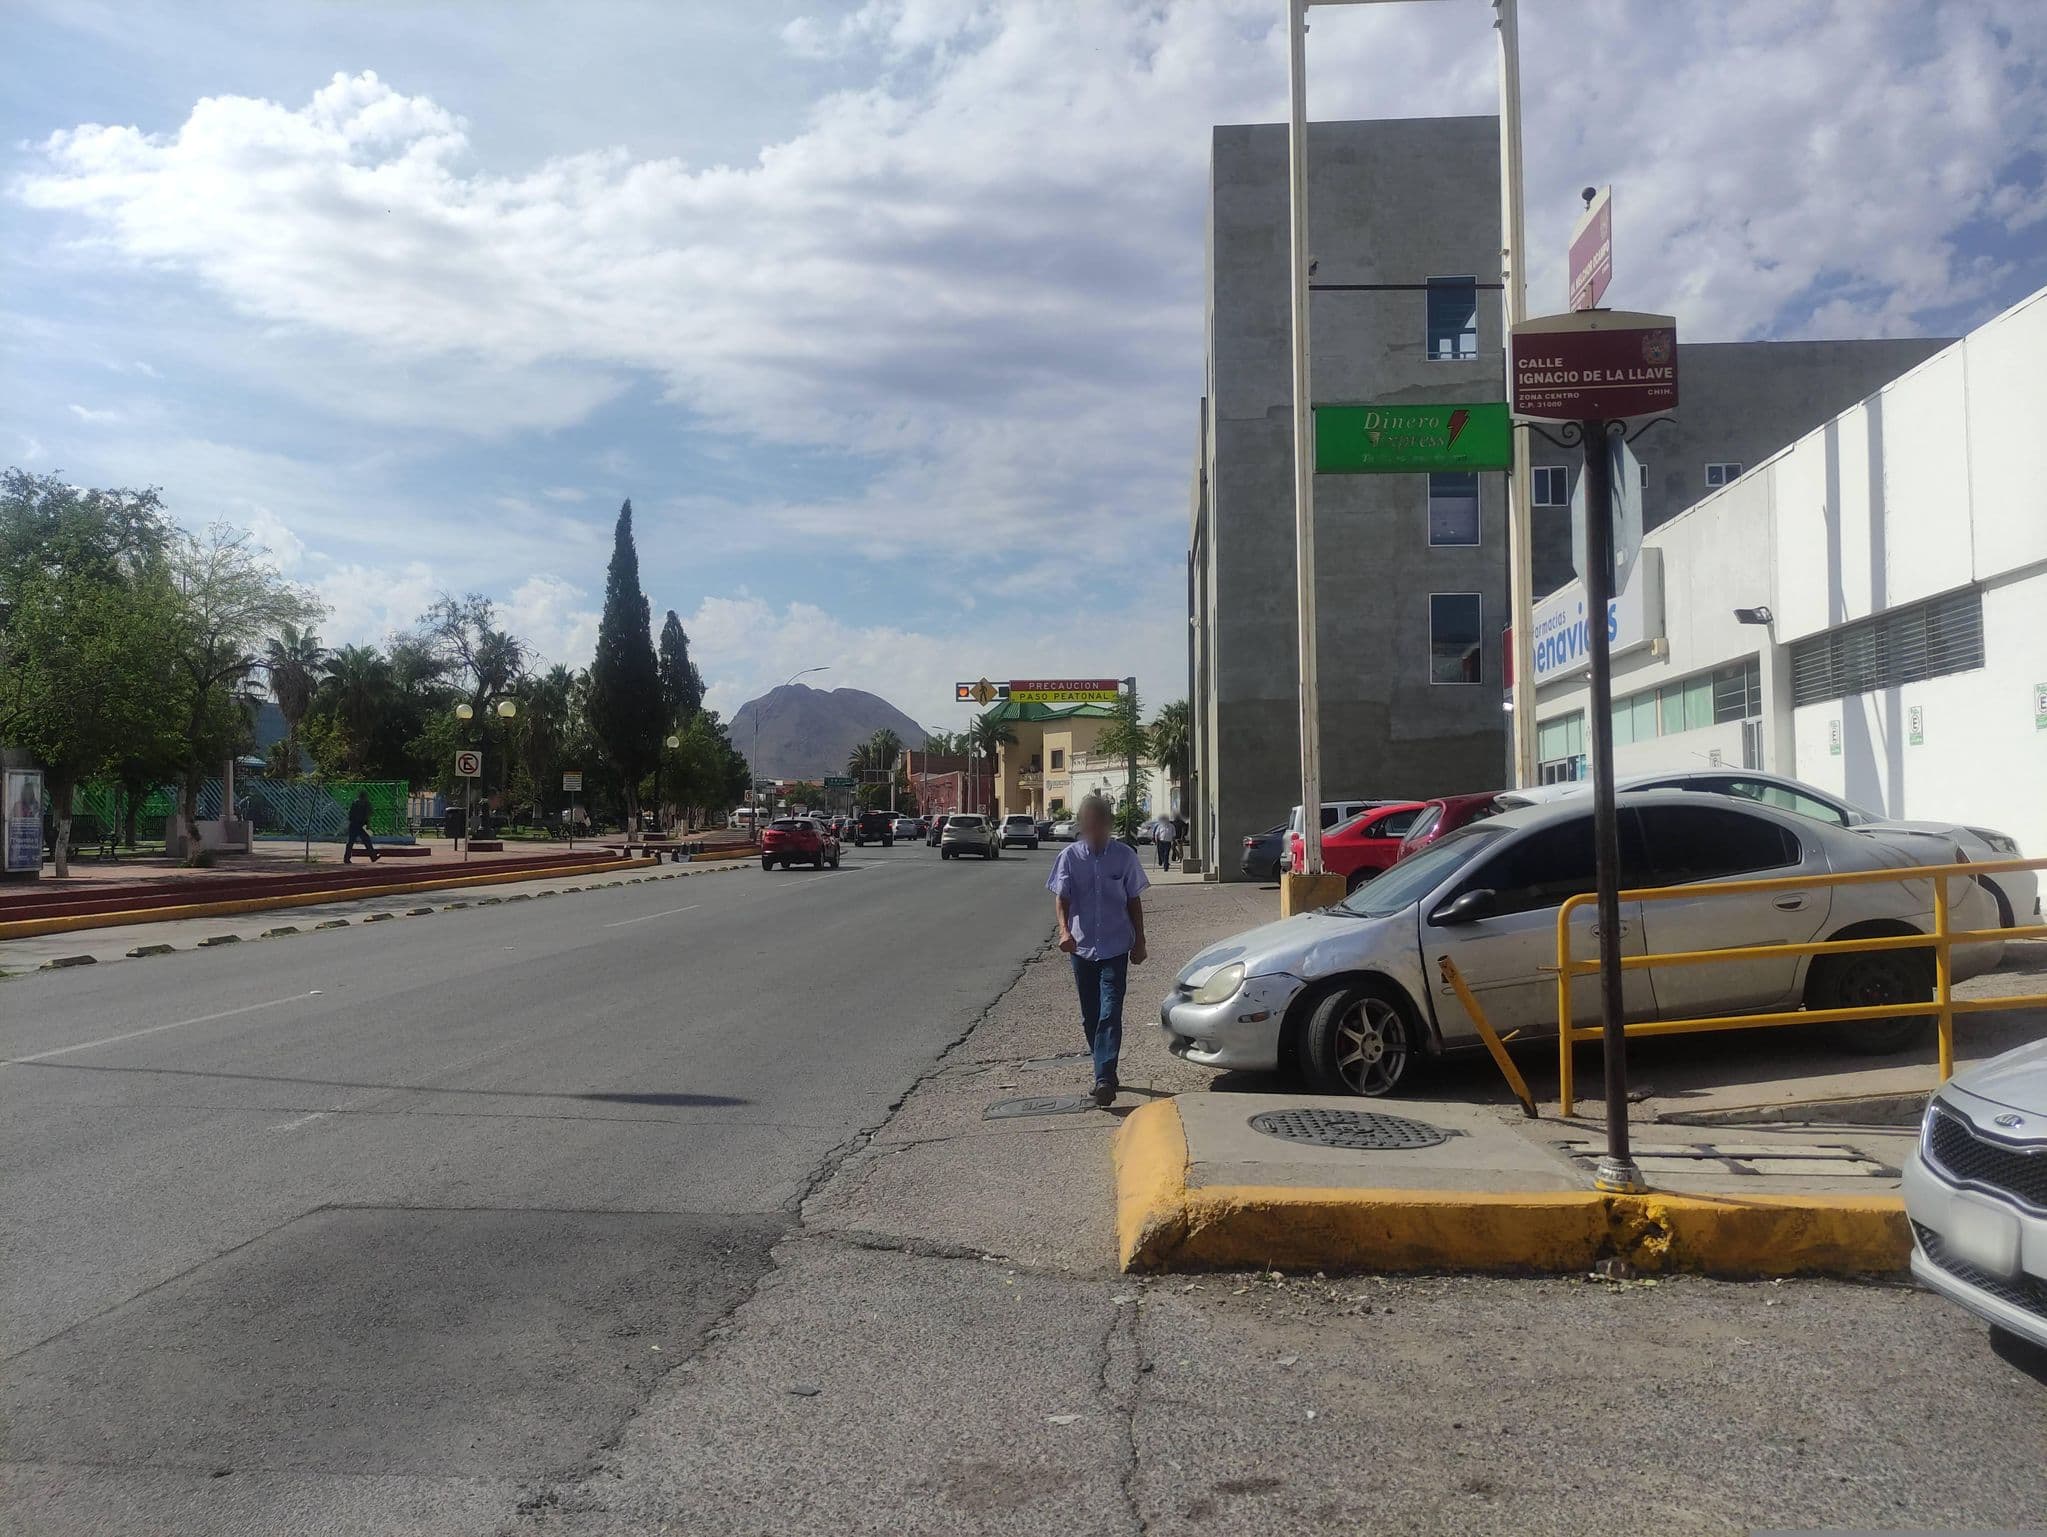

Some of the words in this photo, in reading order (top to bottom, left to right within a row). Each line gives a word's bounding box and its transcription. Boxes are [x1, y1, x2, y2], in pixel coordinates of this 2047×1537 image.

[1518, 357, 1564, 369] CALLE
[1519, 371, 1579, 385] IGNACIO
[1583, 370, 1601, 382] DE
[1606, 369, 1625, 381] LA
[1628, 367, 1673, 380] LLAVE
[1519, 393, 1543, 401] ZONA
[1544, 392, 1580, 400] CENTRO
[1364, 411, 1440, 430] Dinero
[1532, 610, 1566, 639] armacias
[1532, 601, 1617, 674] enavis
[1028, 682, 1100, 690] PRECAUCION
[1019, 692, 1048, 701] PASO
[1053, 692, 1109, 700] PEATONAL
